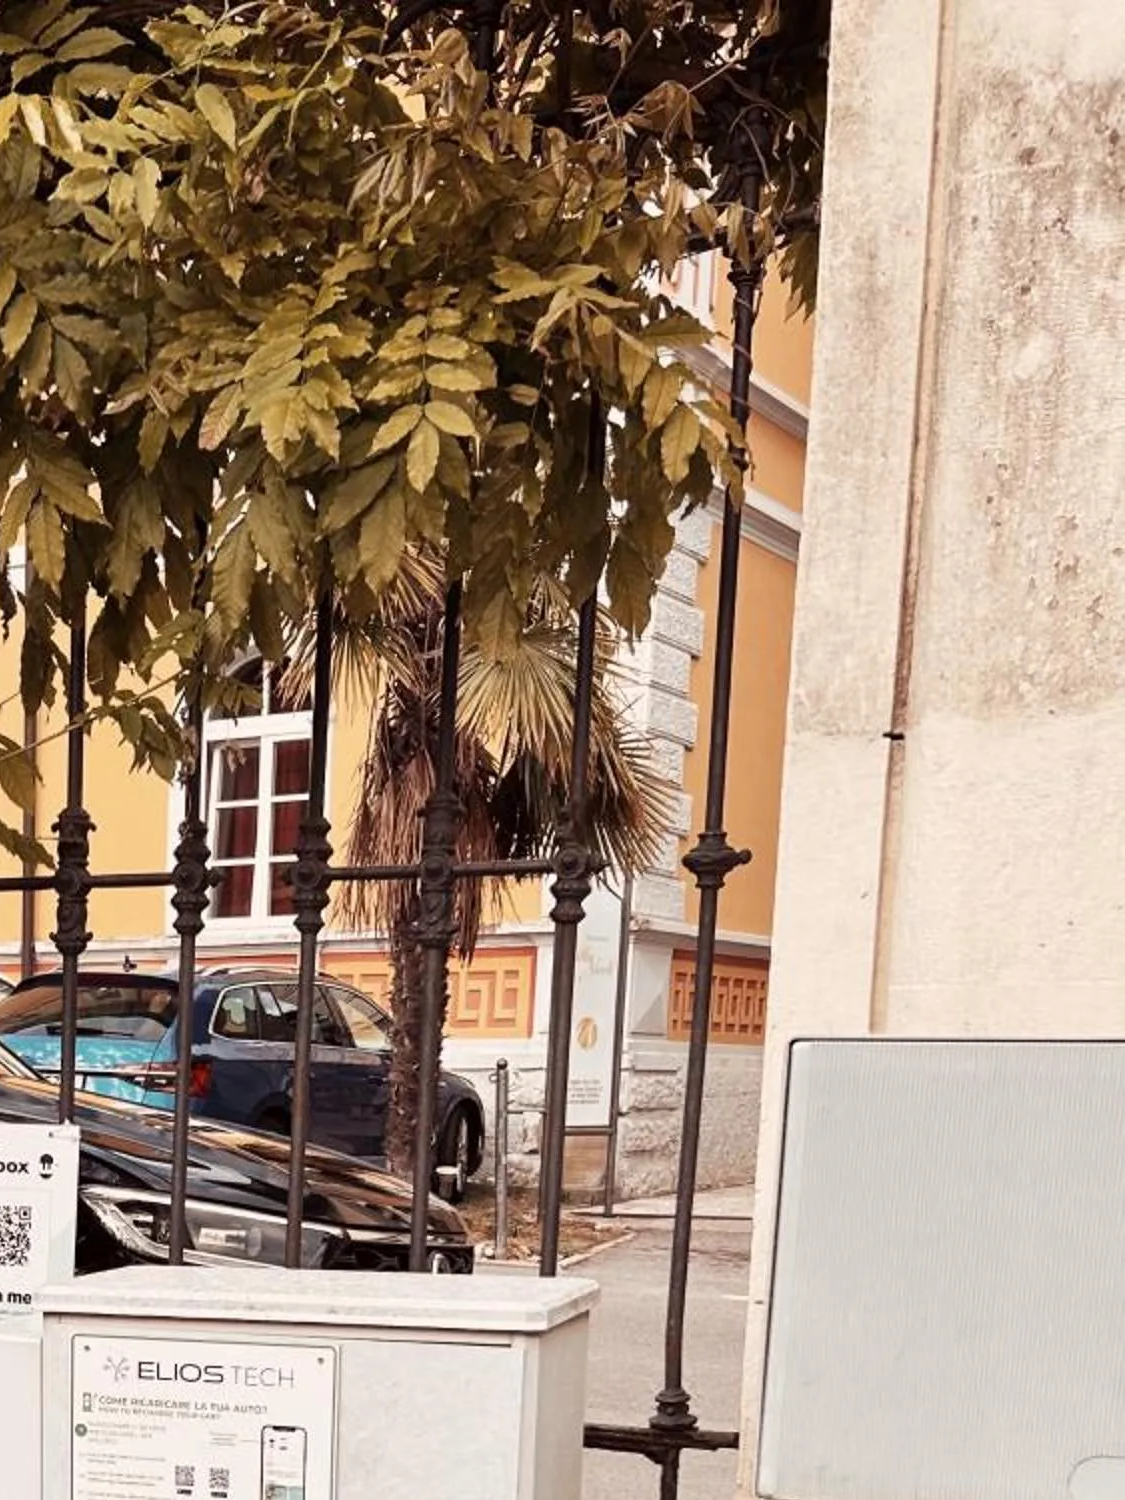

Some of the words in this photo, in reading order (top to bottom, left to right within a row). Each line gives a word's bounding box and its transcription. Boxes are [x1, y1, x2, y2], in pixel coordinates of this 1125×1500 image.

[7, 1292, 32, 1305] me
[138, 1361, 224, 1383] ELIOS
[230, 1365, 295, 1389] TECH
